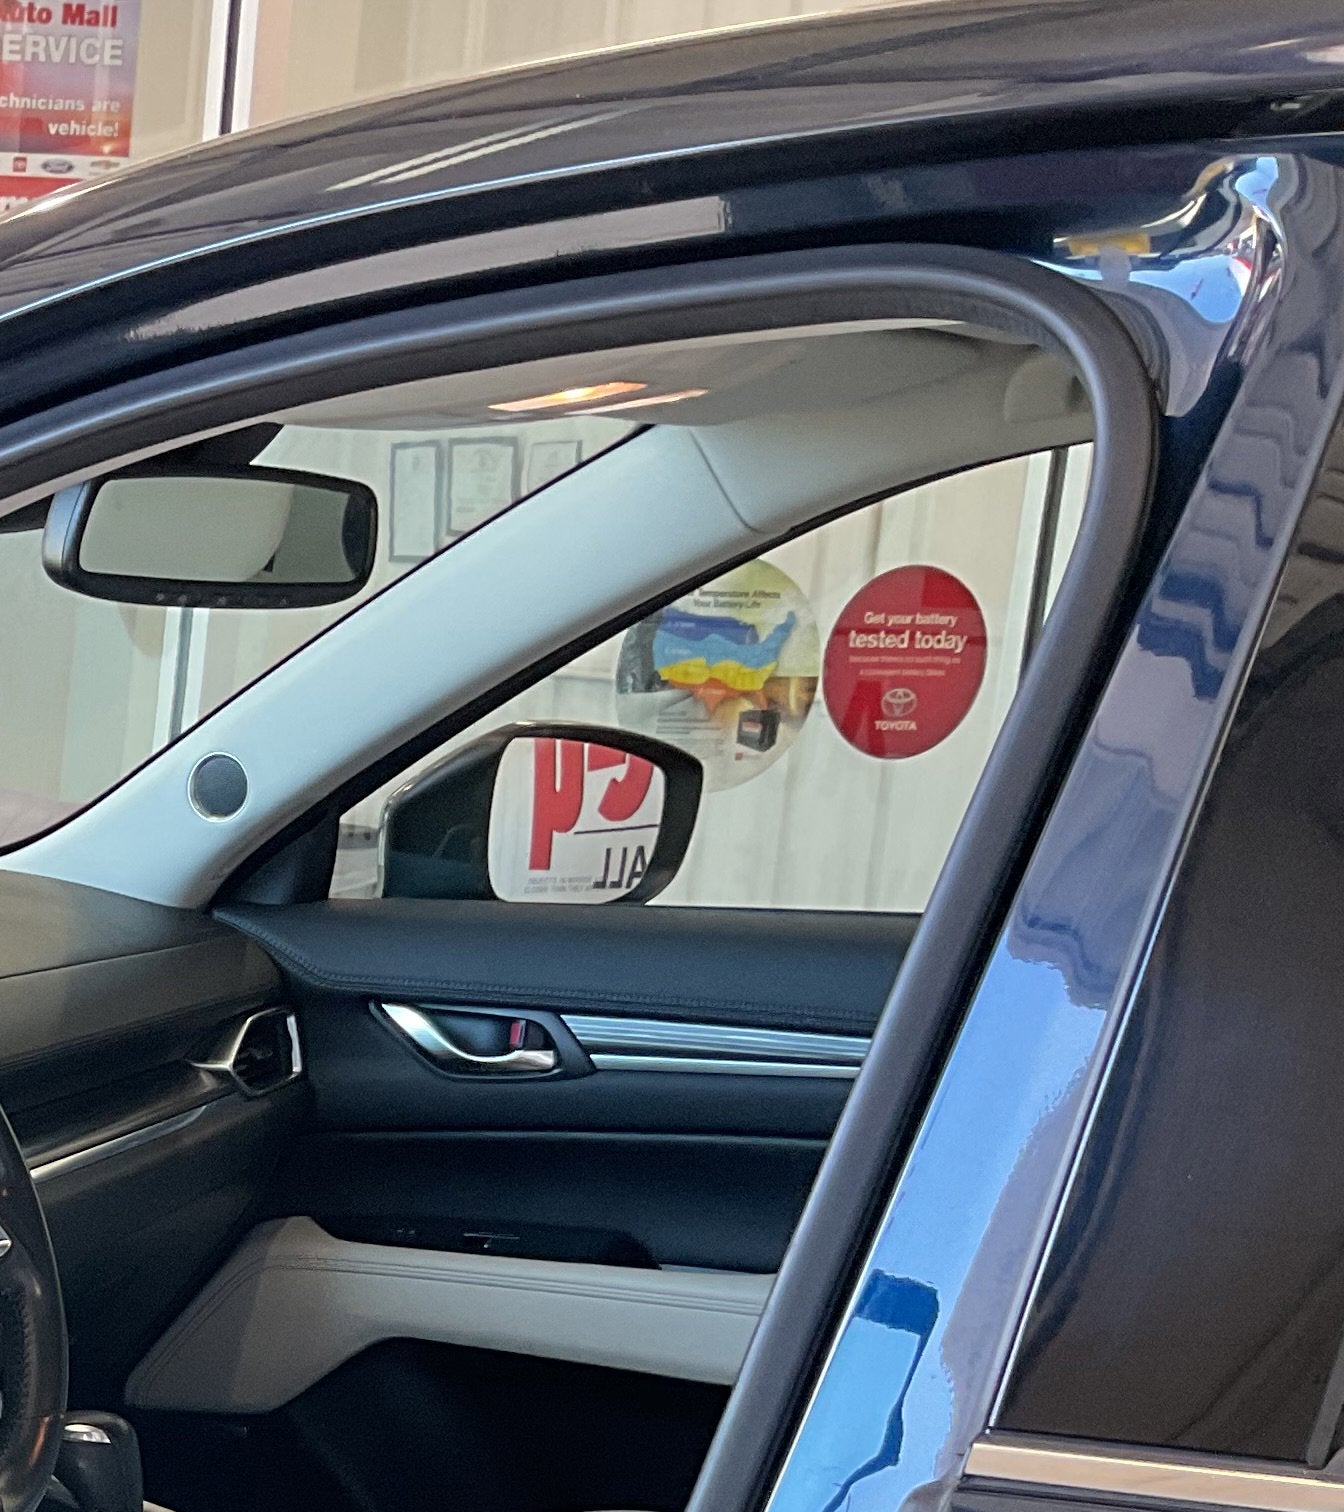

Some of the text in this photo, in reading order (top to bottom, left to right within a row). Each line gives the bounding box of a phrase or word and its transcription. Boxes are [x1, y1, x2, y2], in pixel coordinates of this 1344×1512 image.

[62, 3, 118, 28] Mall
[91, 101, 121, 113] are
[48, 120, 119, 137] vehicle!
[864, 611, 958, 627] Get your battery
[849, 630, 968, 653] tested today
[874, 720, 917, 731] TOYOTA
